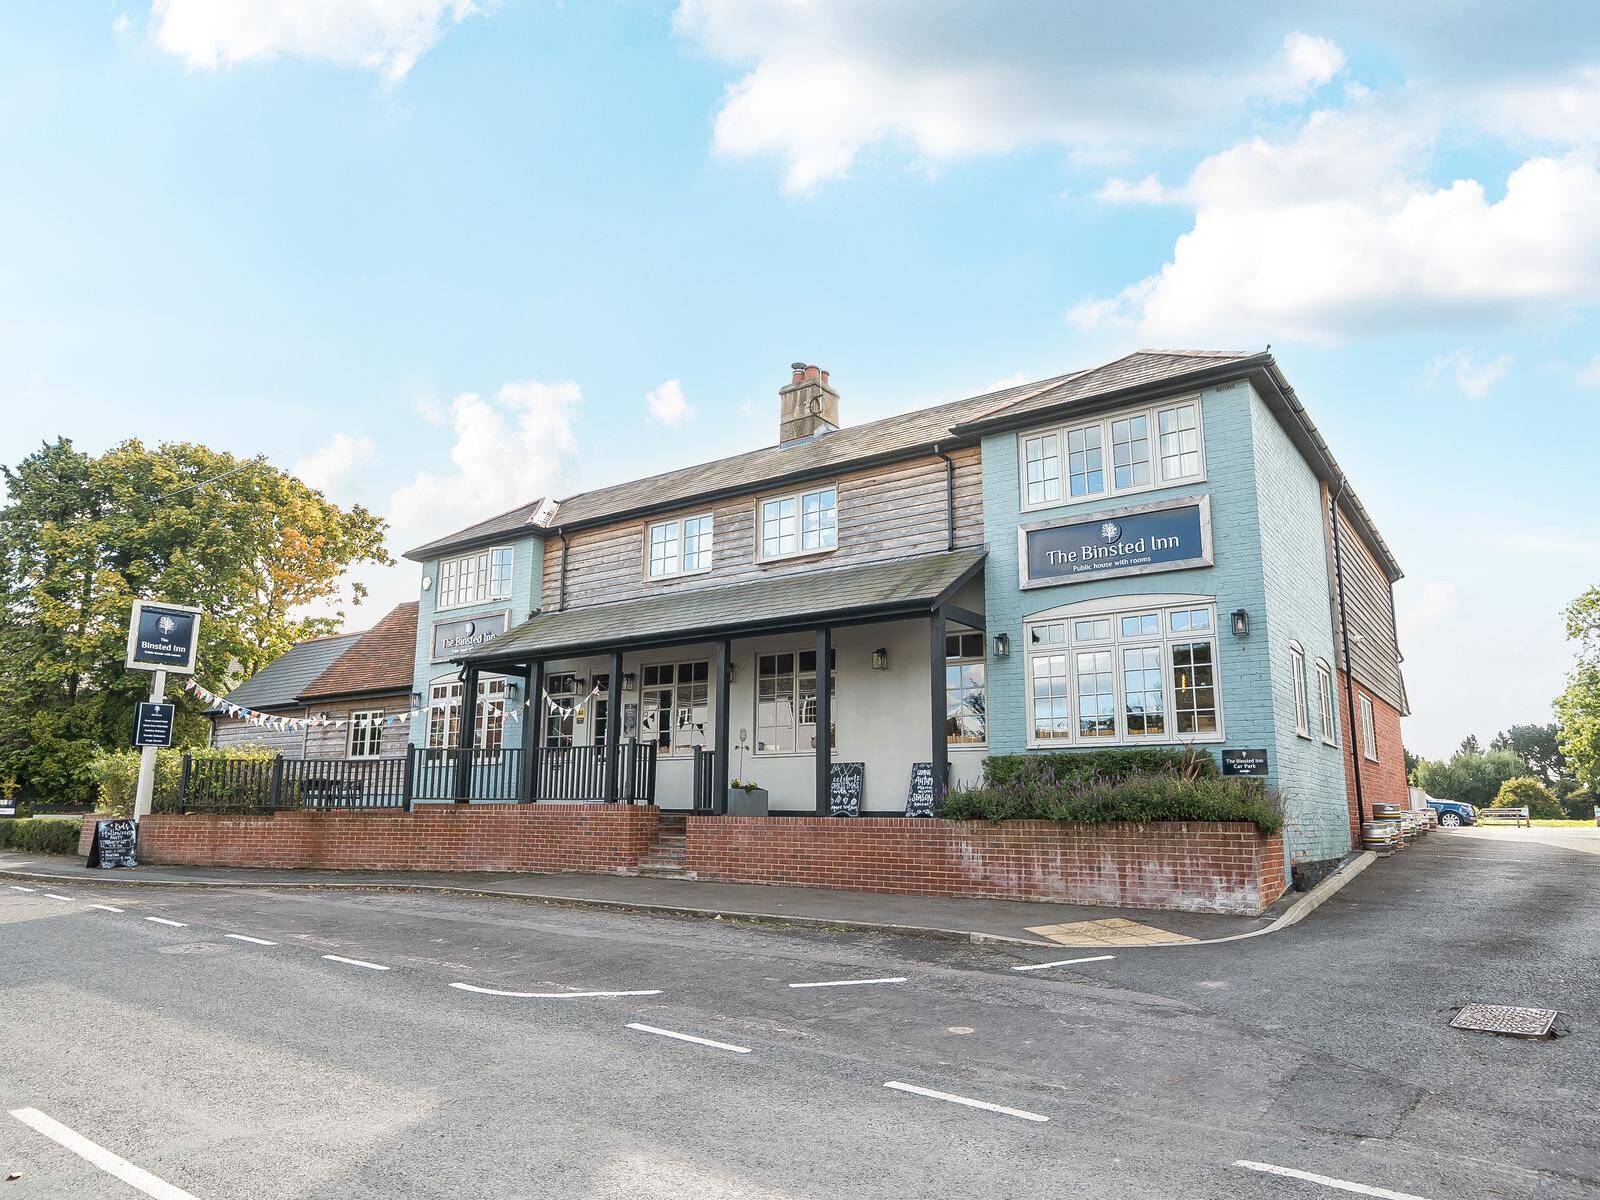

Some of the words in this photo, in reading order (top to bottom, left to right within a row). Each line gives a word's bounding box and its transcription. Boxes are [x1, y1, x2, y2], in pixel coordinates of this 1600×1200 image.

[1046, 549, 1079, 566] The
[1080, 537, 1146, 561] Binsted
[1151, 535, 1180, 551] Inn
[1072, 564, 1092, 572] Public
[1093, 560, 1113, 569] house
[1114, 558, 1129, 567] with
[1130, 556, 1152, 564] rooms
[141, 641, 172, 651] Binsted
[173, 644, 186, 653] Inn
[441, 638, 455, 649] The
[455, 633, 483, 647] Binsted
